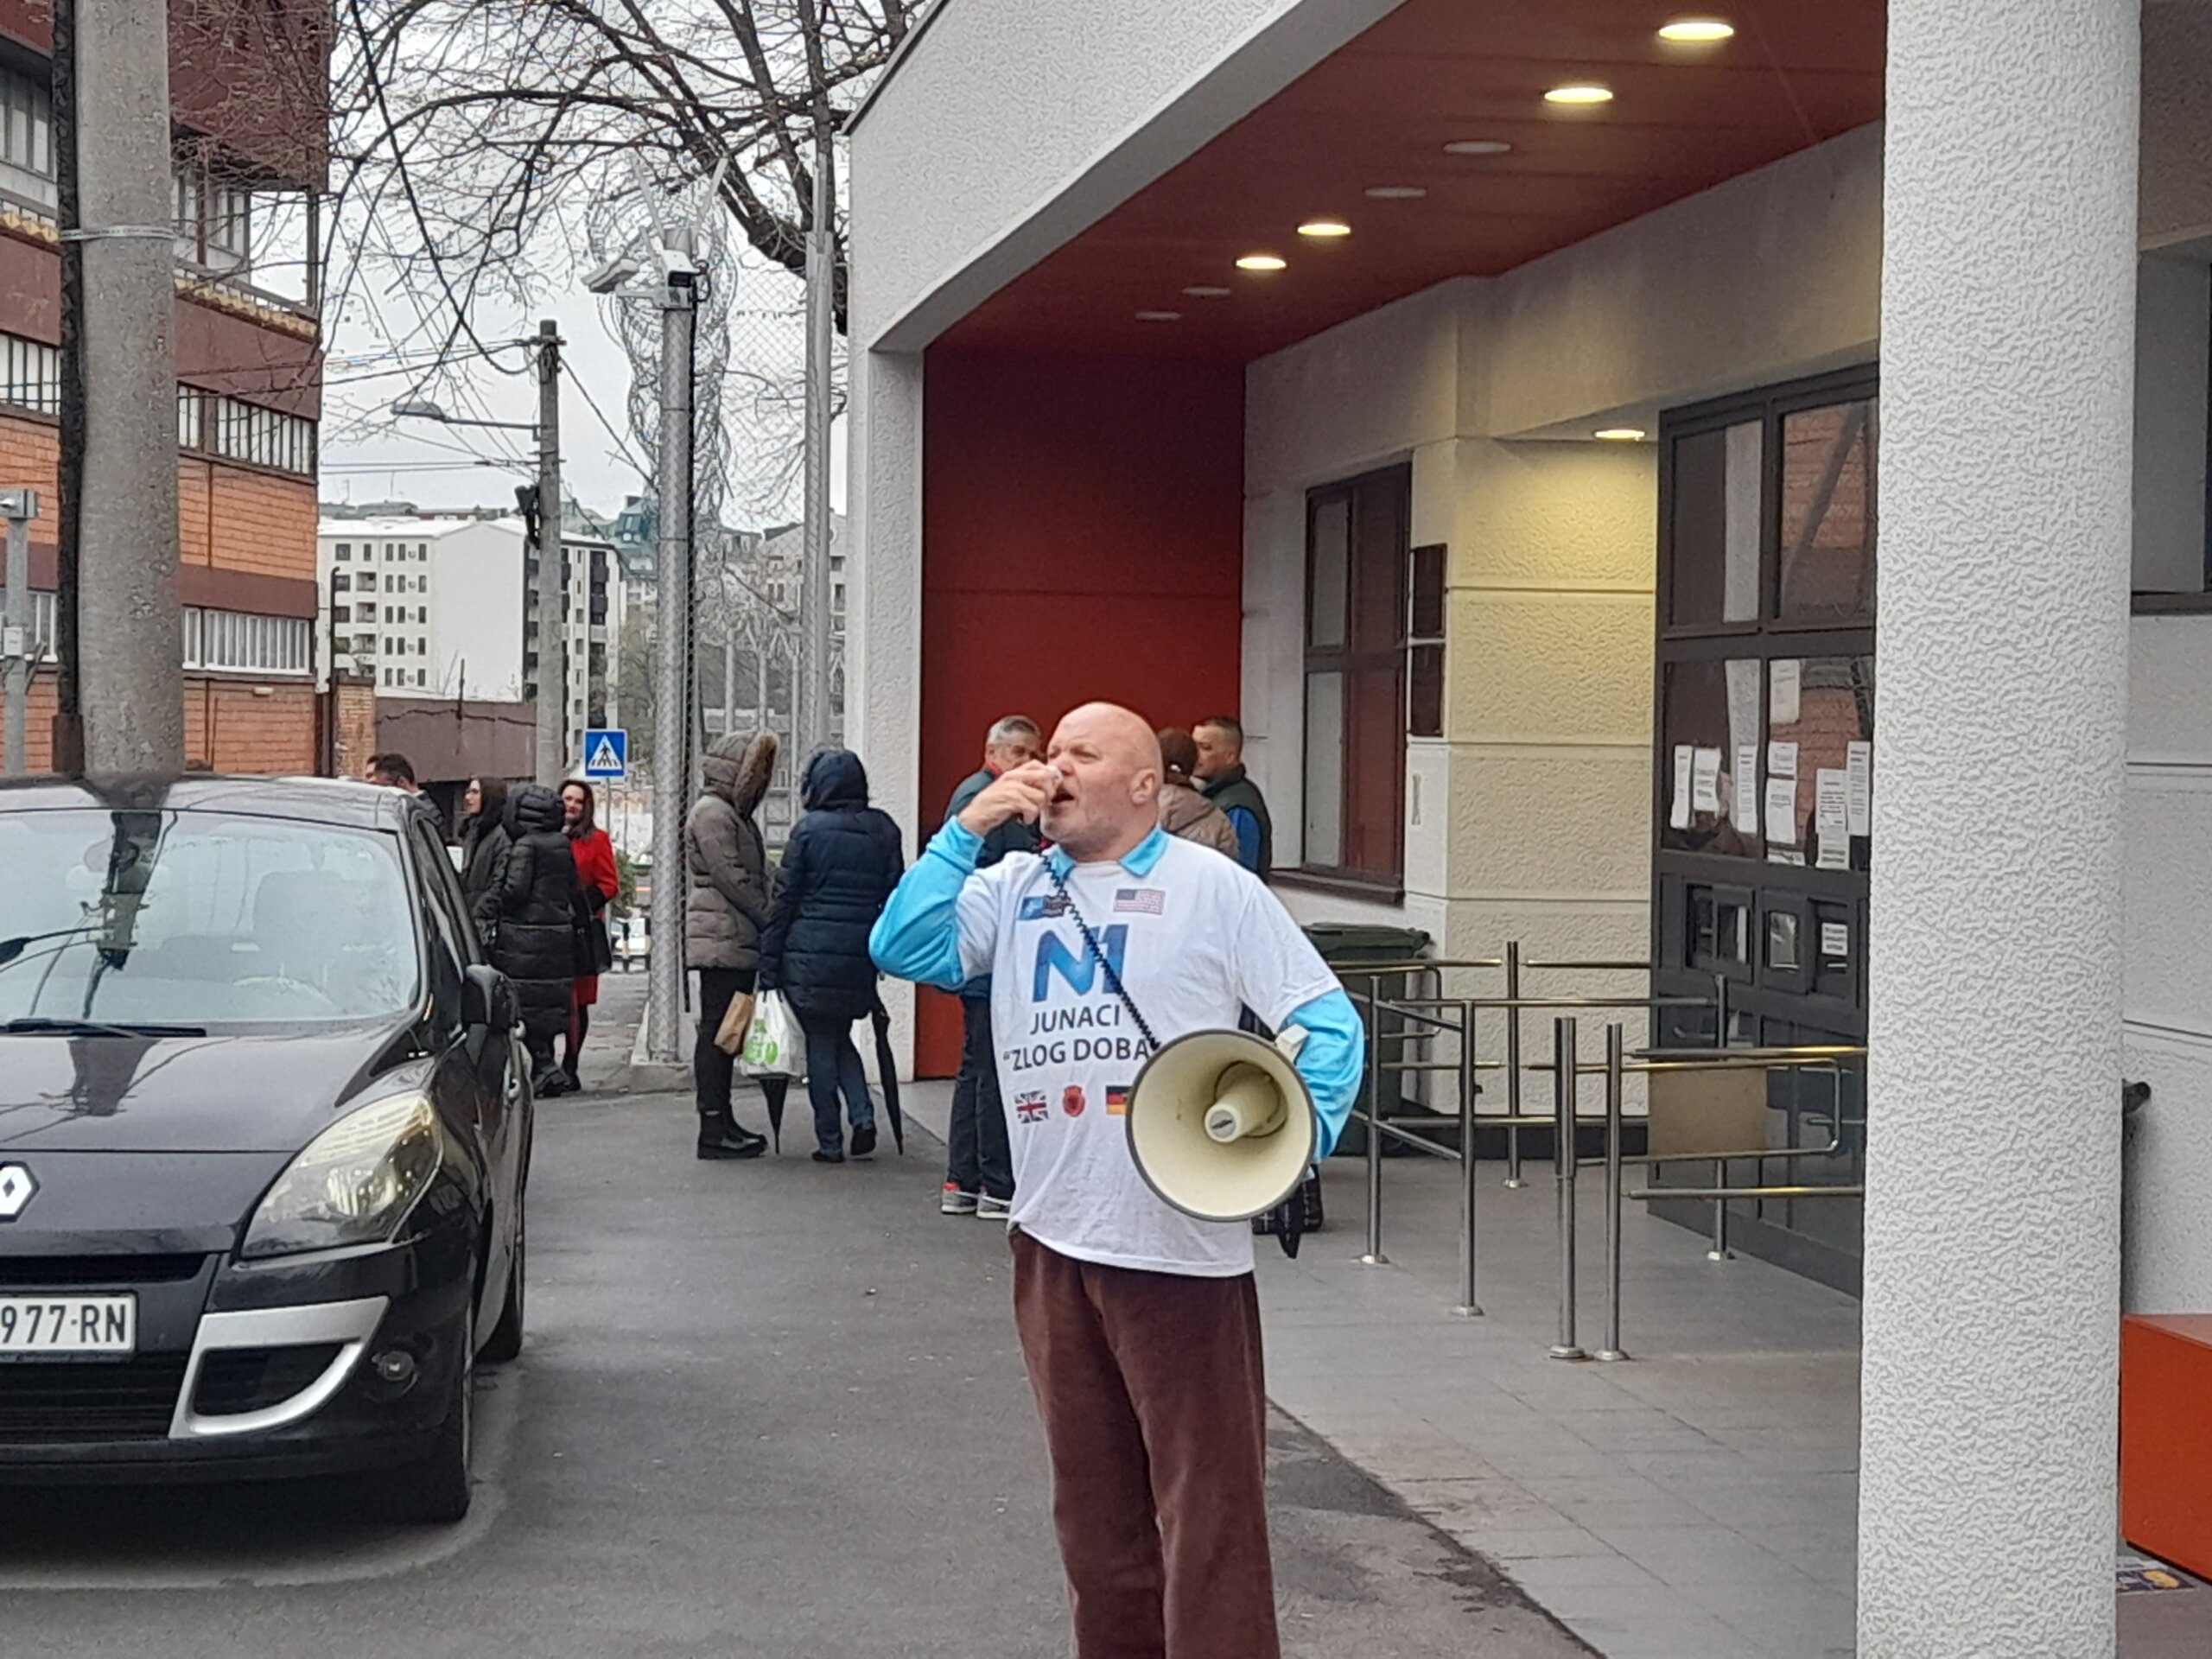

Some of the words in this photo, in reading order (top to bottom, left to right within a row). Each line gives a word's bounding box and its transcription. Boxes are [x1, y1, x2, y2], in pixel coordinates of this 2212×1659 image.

[1033, 924, 1128, 1002] N1
[1030, 1004, 1121, 1035] JUNACI
[1073, 1037, 1152, 1062] DOBA
